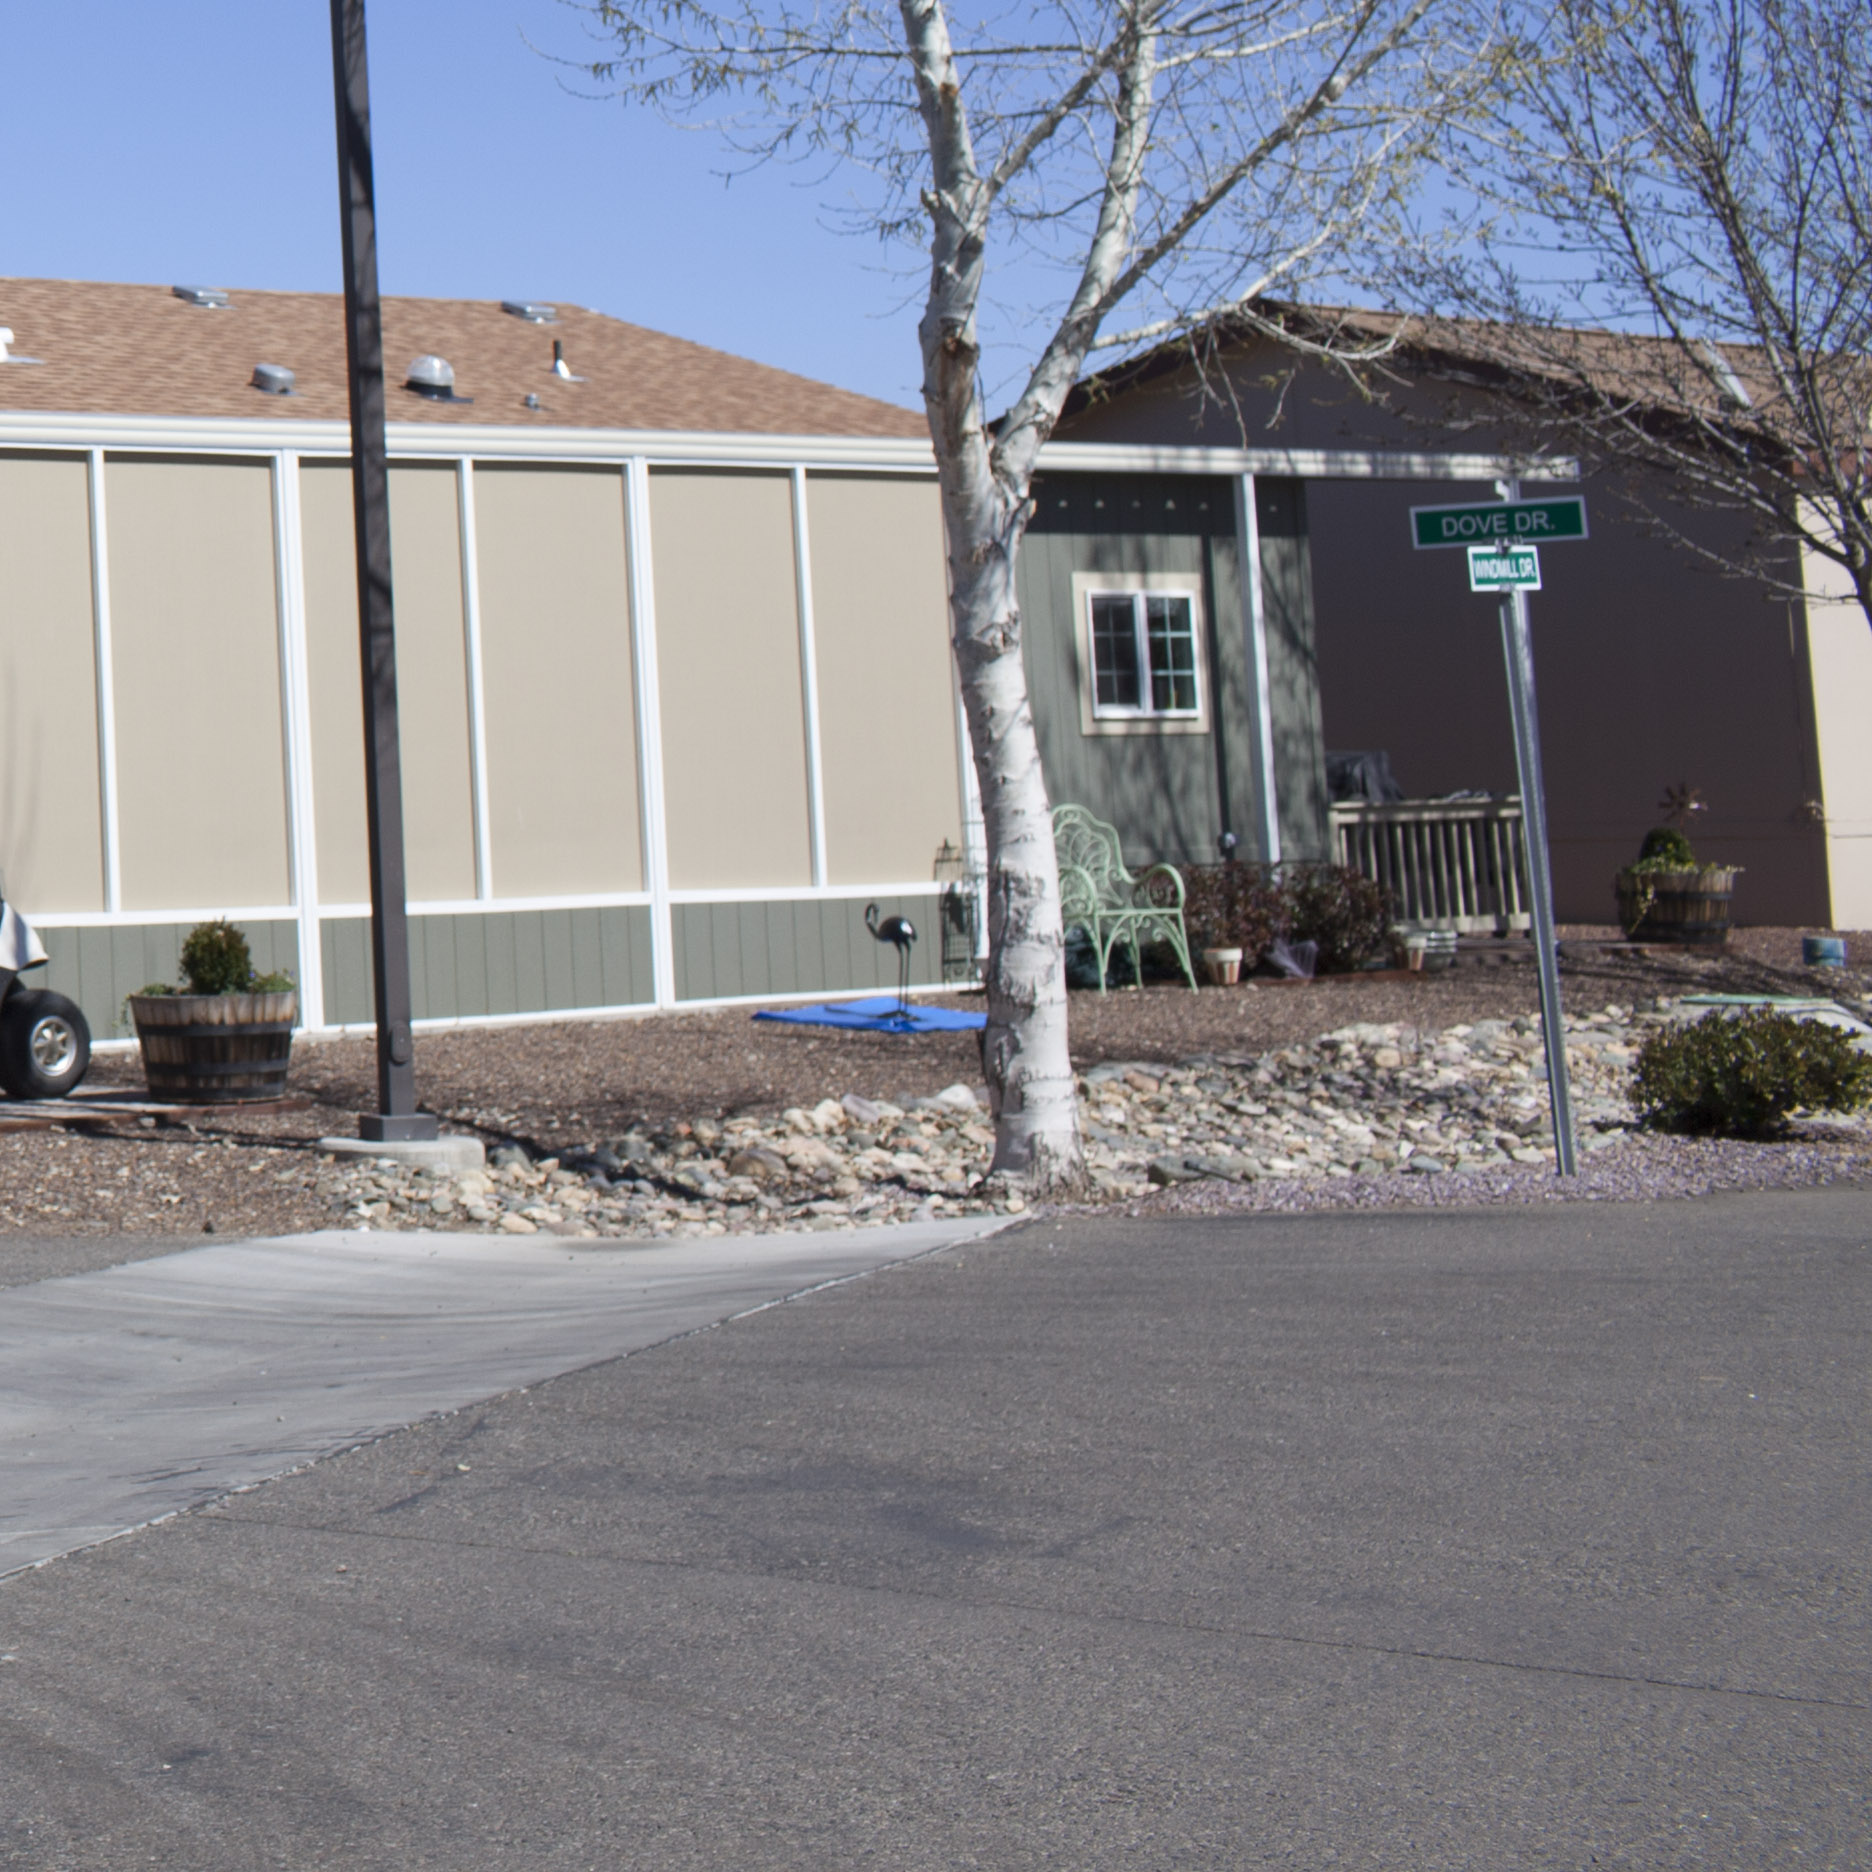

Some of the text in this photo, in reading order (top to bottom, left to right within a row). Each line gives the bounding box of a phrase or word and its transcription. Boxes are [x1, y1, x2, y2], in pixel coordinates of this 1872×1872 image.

[1441, 510, 1556, 537] DOVE DR.
[1473, 558, 1520, 579] WINDMILL
